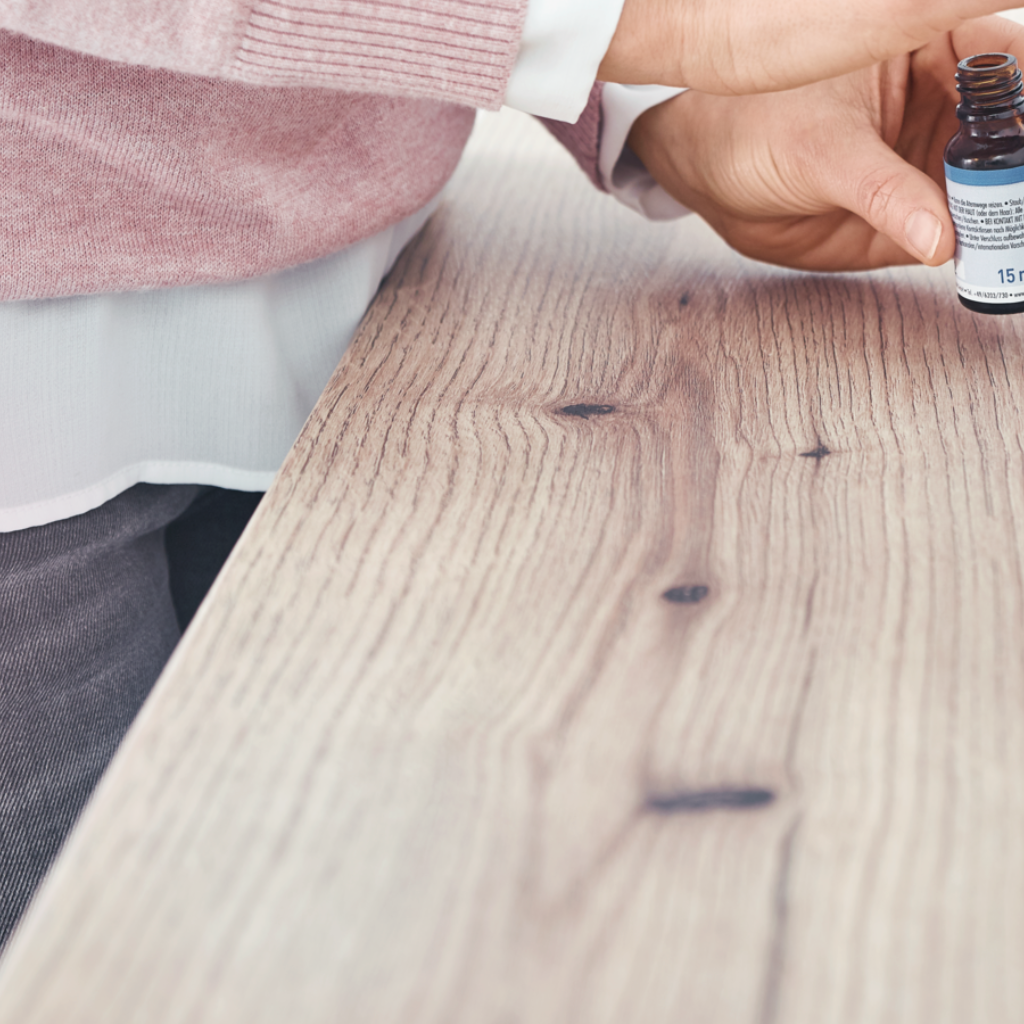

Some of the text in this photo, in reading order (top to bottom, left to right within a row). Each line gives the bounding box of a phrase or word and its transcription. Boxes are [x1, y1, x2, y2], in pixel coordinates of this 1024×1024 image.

[988, 208, 998, 216] dem
[993, 216, 1013, 225] KONTAKT
[998, 268, 1015, 284] 15
